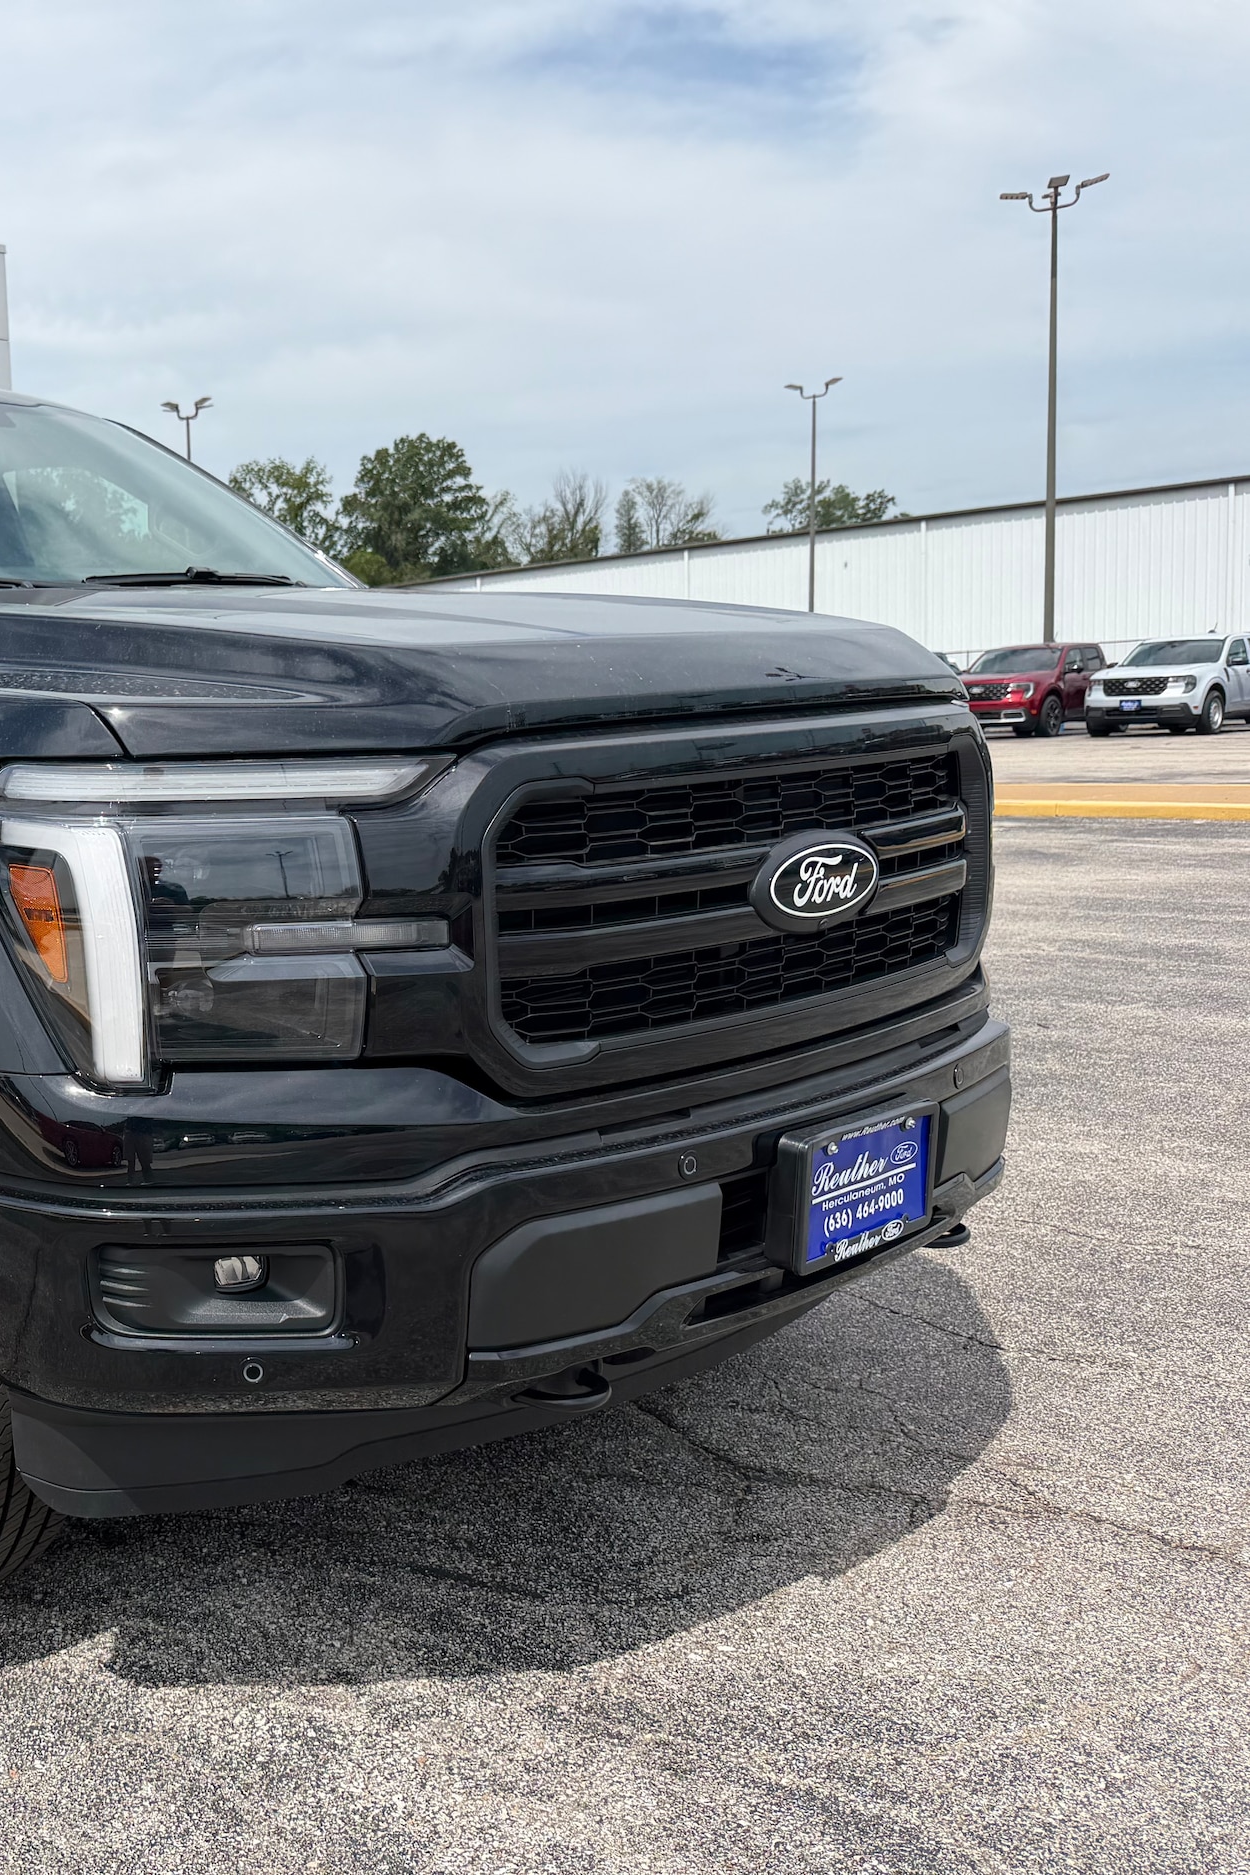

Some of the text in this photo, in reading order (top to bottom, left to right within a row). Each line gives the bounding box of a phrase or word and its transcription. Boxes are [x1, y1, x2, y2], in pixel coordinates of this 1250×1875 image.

[793, 854, 859, 908] Ford
[841, 1116, 906, 1141] www.Reuther.com
[811, 1151, 889, 1196] Reuther
[822, 1173, 905, 1211] Herculaneum, MO
[824, 1188, 904, 1238] (636) 464-9000
[834, 1231, 882, 1262] Reuther
